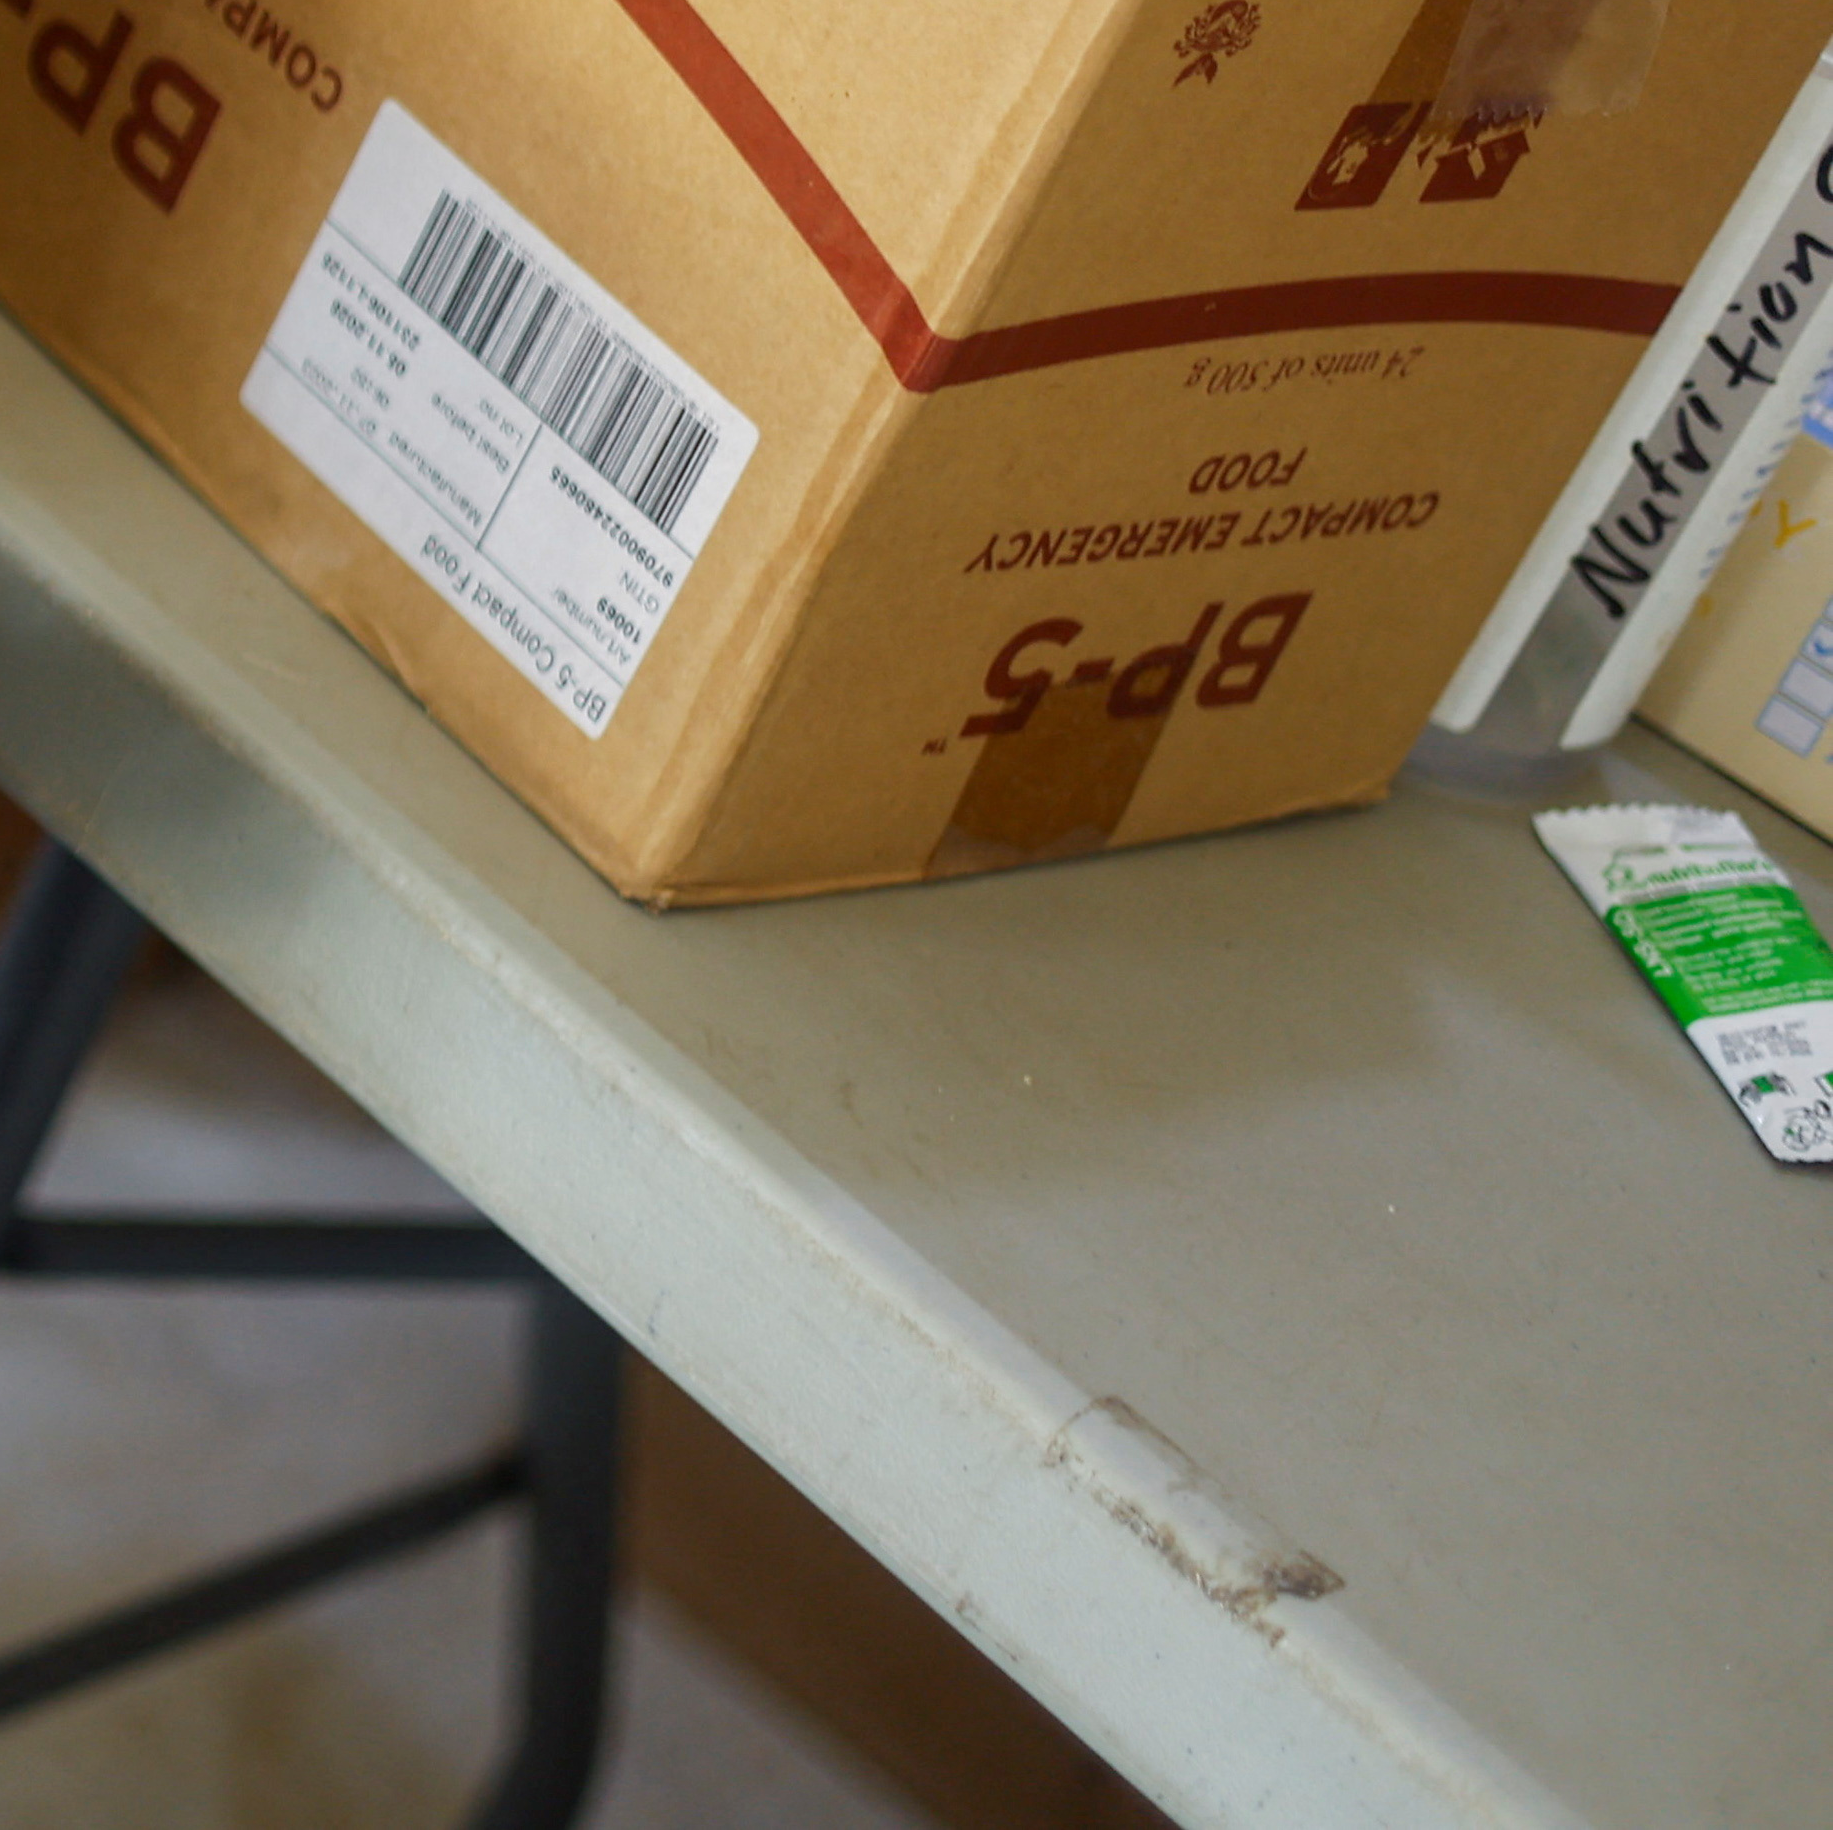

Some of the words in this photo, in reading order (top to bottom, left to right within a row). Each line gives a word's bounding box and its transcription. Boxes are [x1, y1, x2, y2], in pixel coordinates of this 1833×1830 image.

[1207, 361, 1271, 395] 500
[1265, 357, 1305, 392] of
[1314, 351, 1380, 386] units
[1381, 346, 1425, 378] 24
[1569, 230, 1833, 619] Nutrition
[479, 438, 511, 475] Best
[1189, 447, 1308, 494] FOOD
[964, 512, 1241, 574] EMERGENCY
[1241, 490, 1440, 547] COMPACT
[420, 533, 472, 595] Food
[470, 580, 556, 673] Compact
[958, 590, 1315, 739] BP-5
[555, 662, 607, 725] BP-5
